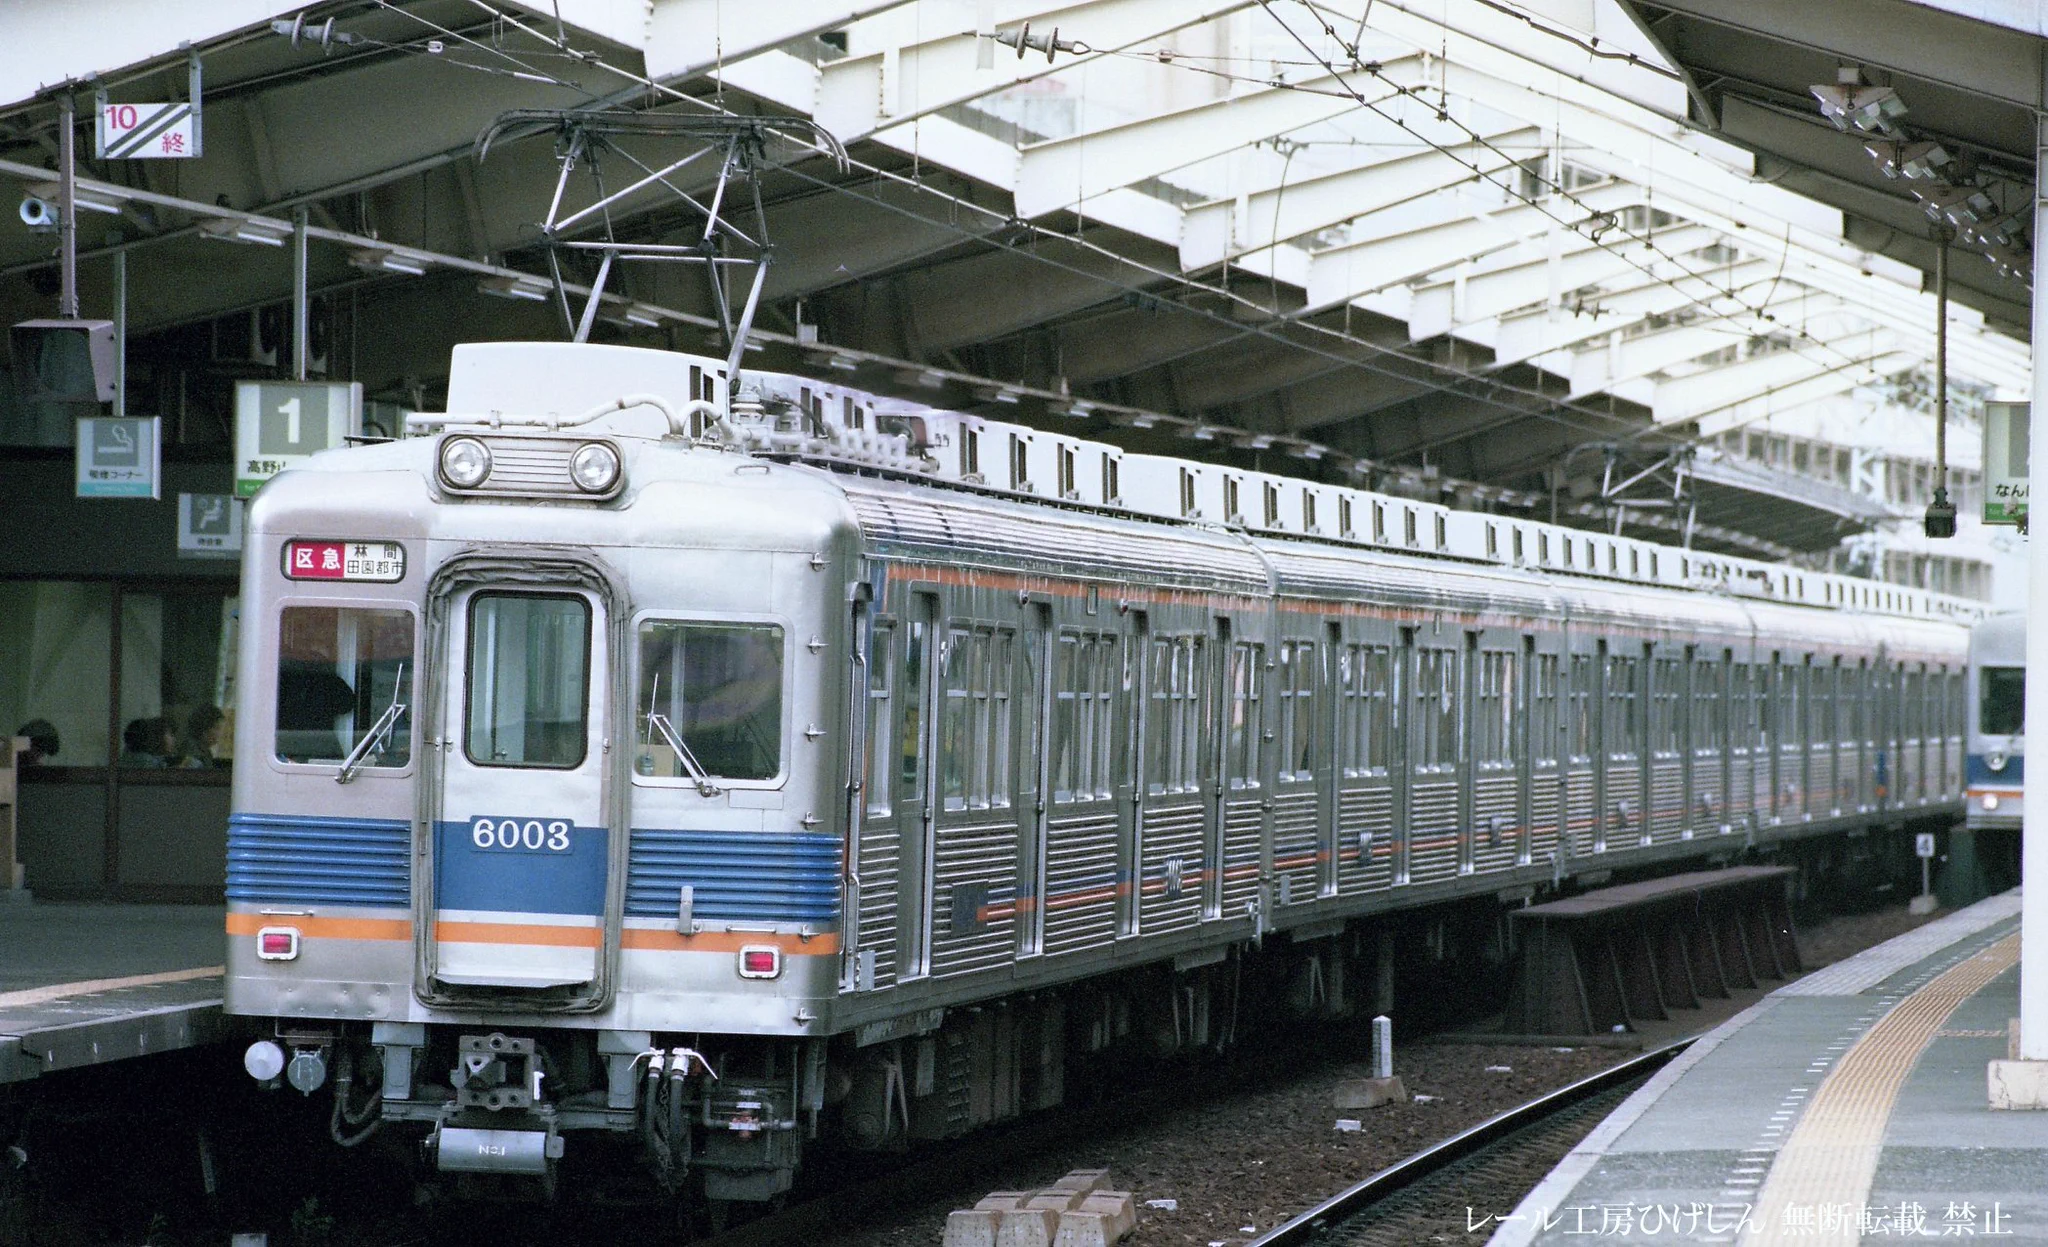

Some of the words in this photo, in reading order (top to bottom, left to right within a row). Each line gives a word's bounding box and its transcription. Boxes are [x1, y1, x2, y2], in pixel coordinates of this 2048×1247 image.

[106, 105, 138, 129] 10
[163, 132, 184, 153] 終
[278, 398, 300, 443] 1
[296, 547, 341, 569] 区急
[347, 560, 403, 575] 田園都市
[473, 819, 570, 850] 6003
